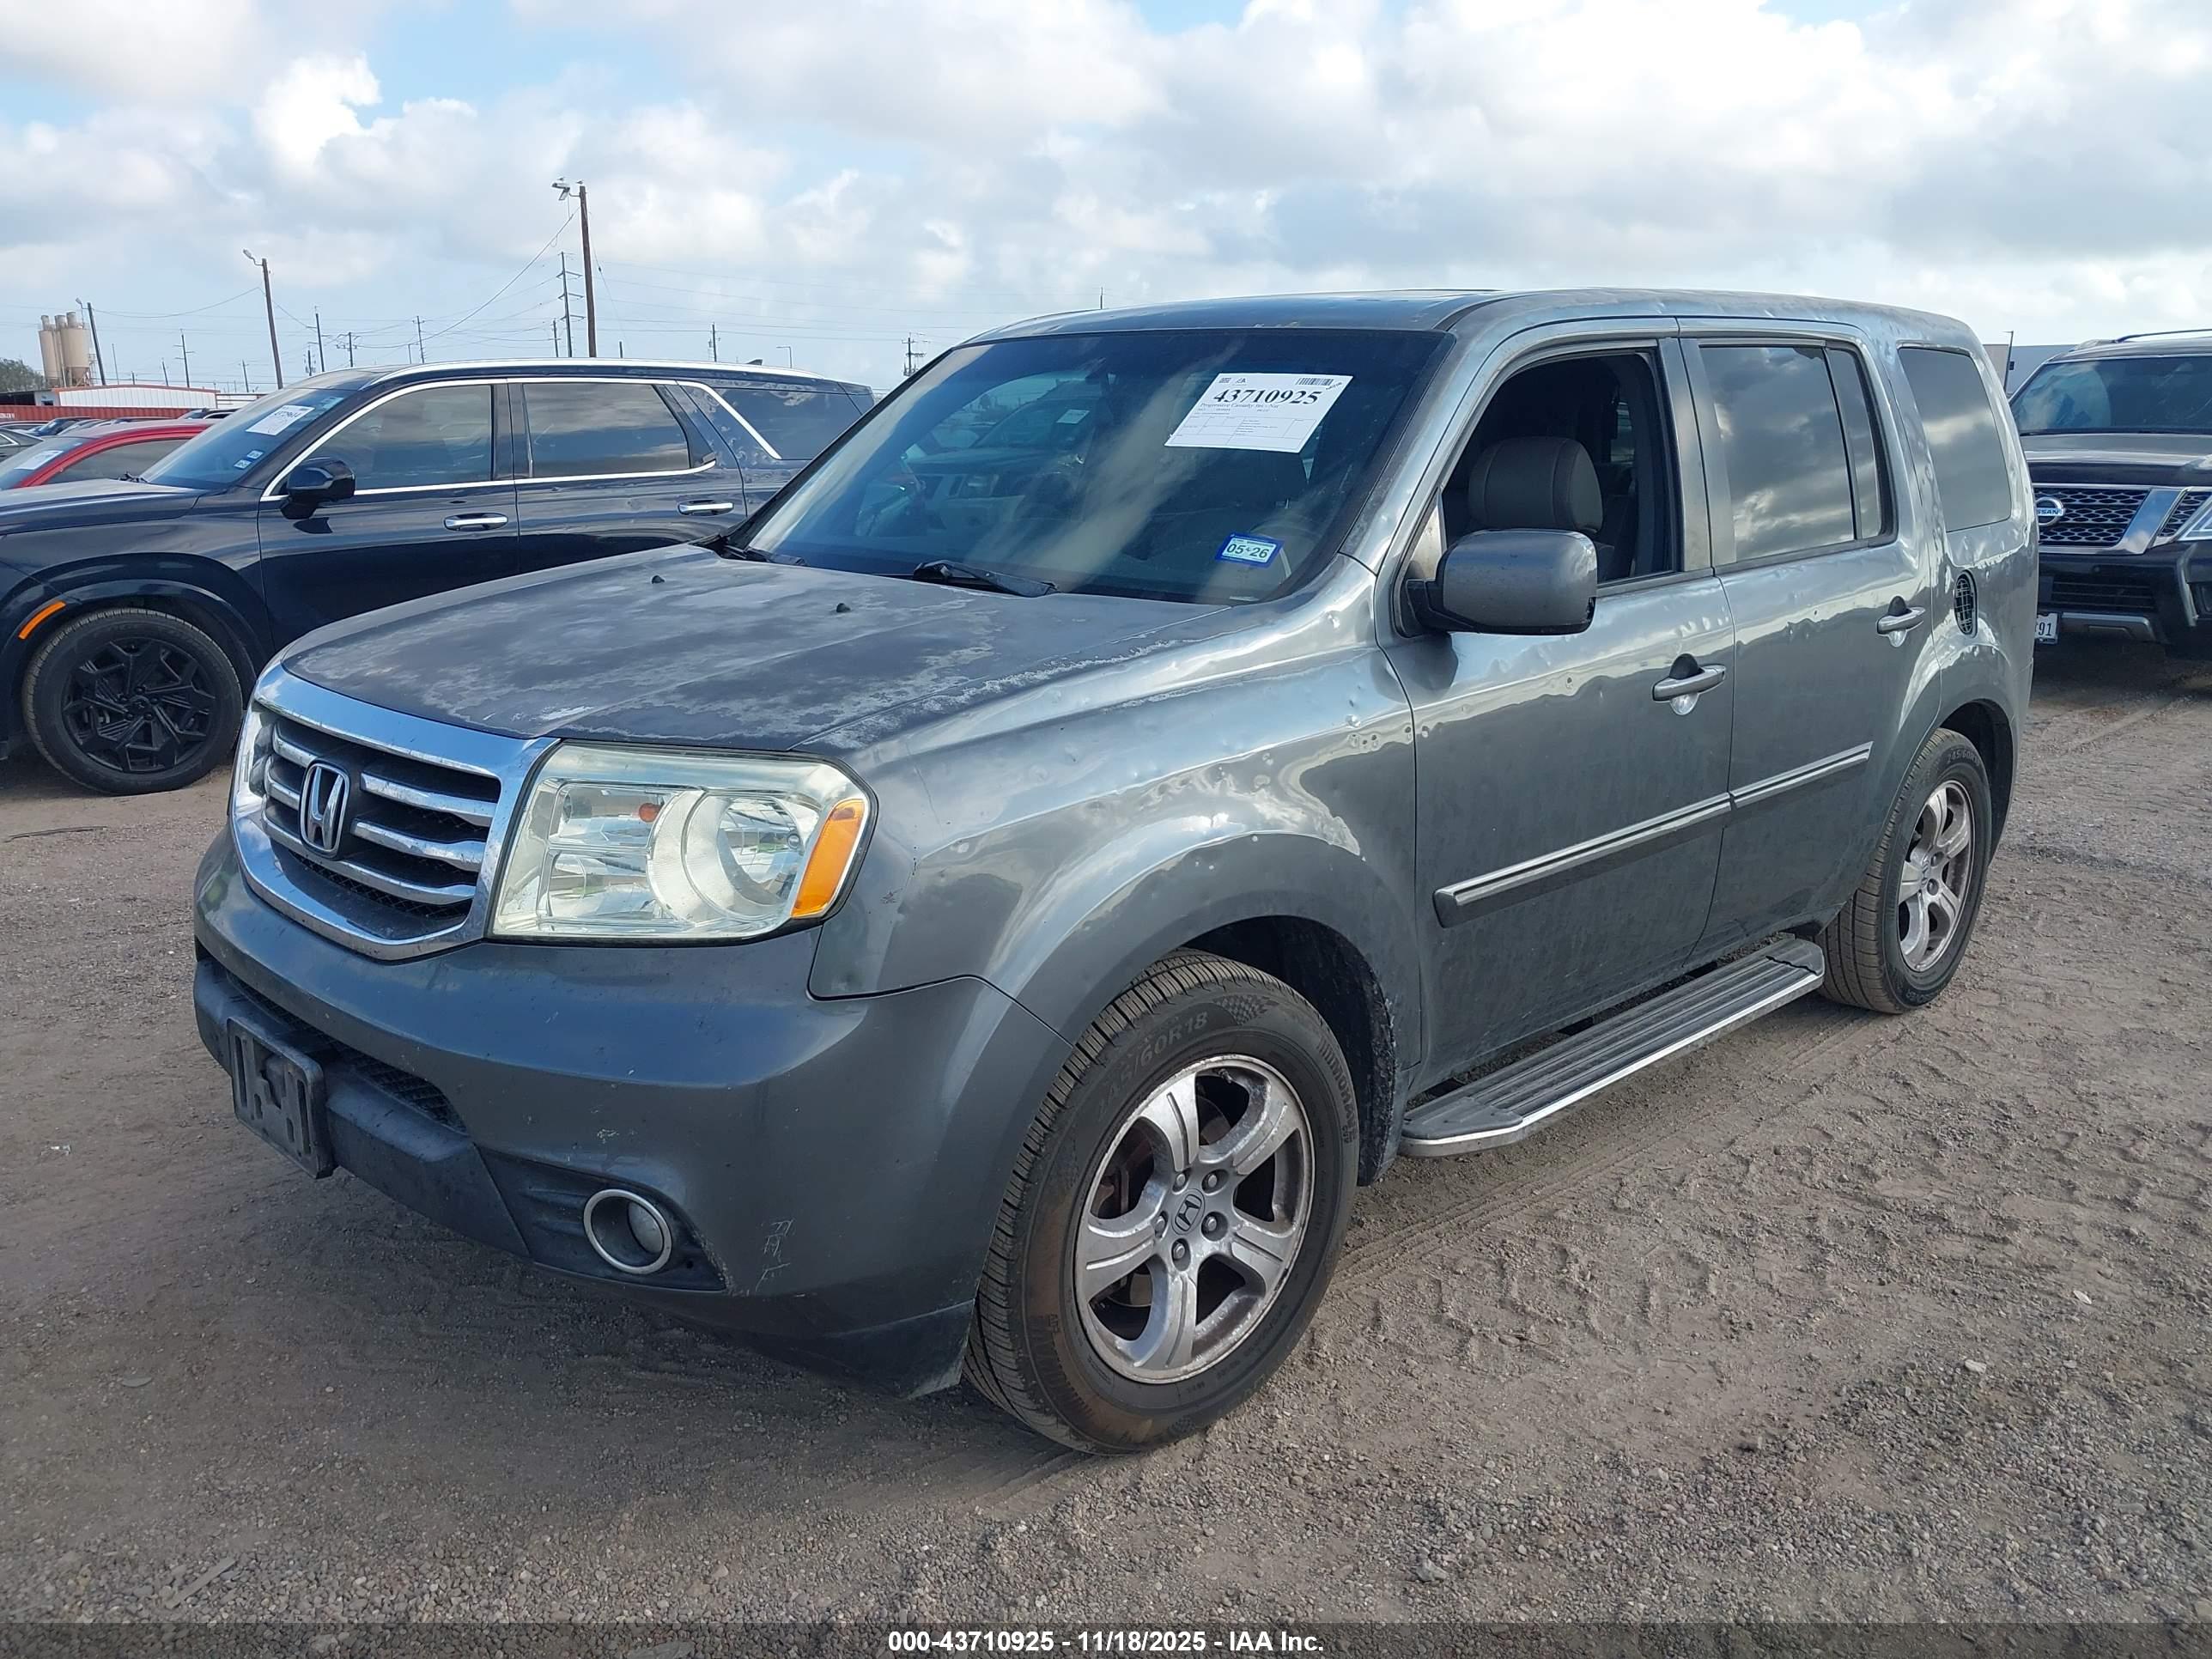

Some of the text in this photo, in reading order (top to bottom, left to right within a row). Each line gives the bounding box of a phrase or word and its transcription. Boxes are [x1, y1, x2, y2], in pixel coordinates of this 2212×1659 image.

[1213, 389, 1323, 404] 43710925
[1226, 544, 1270, 559] 05 26
